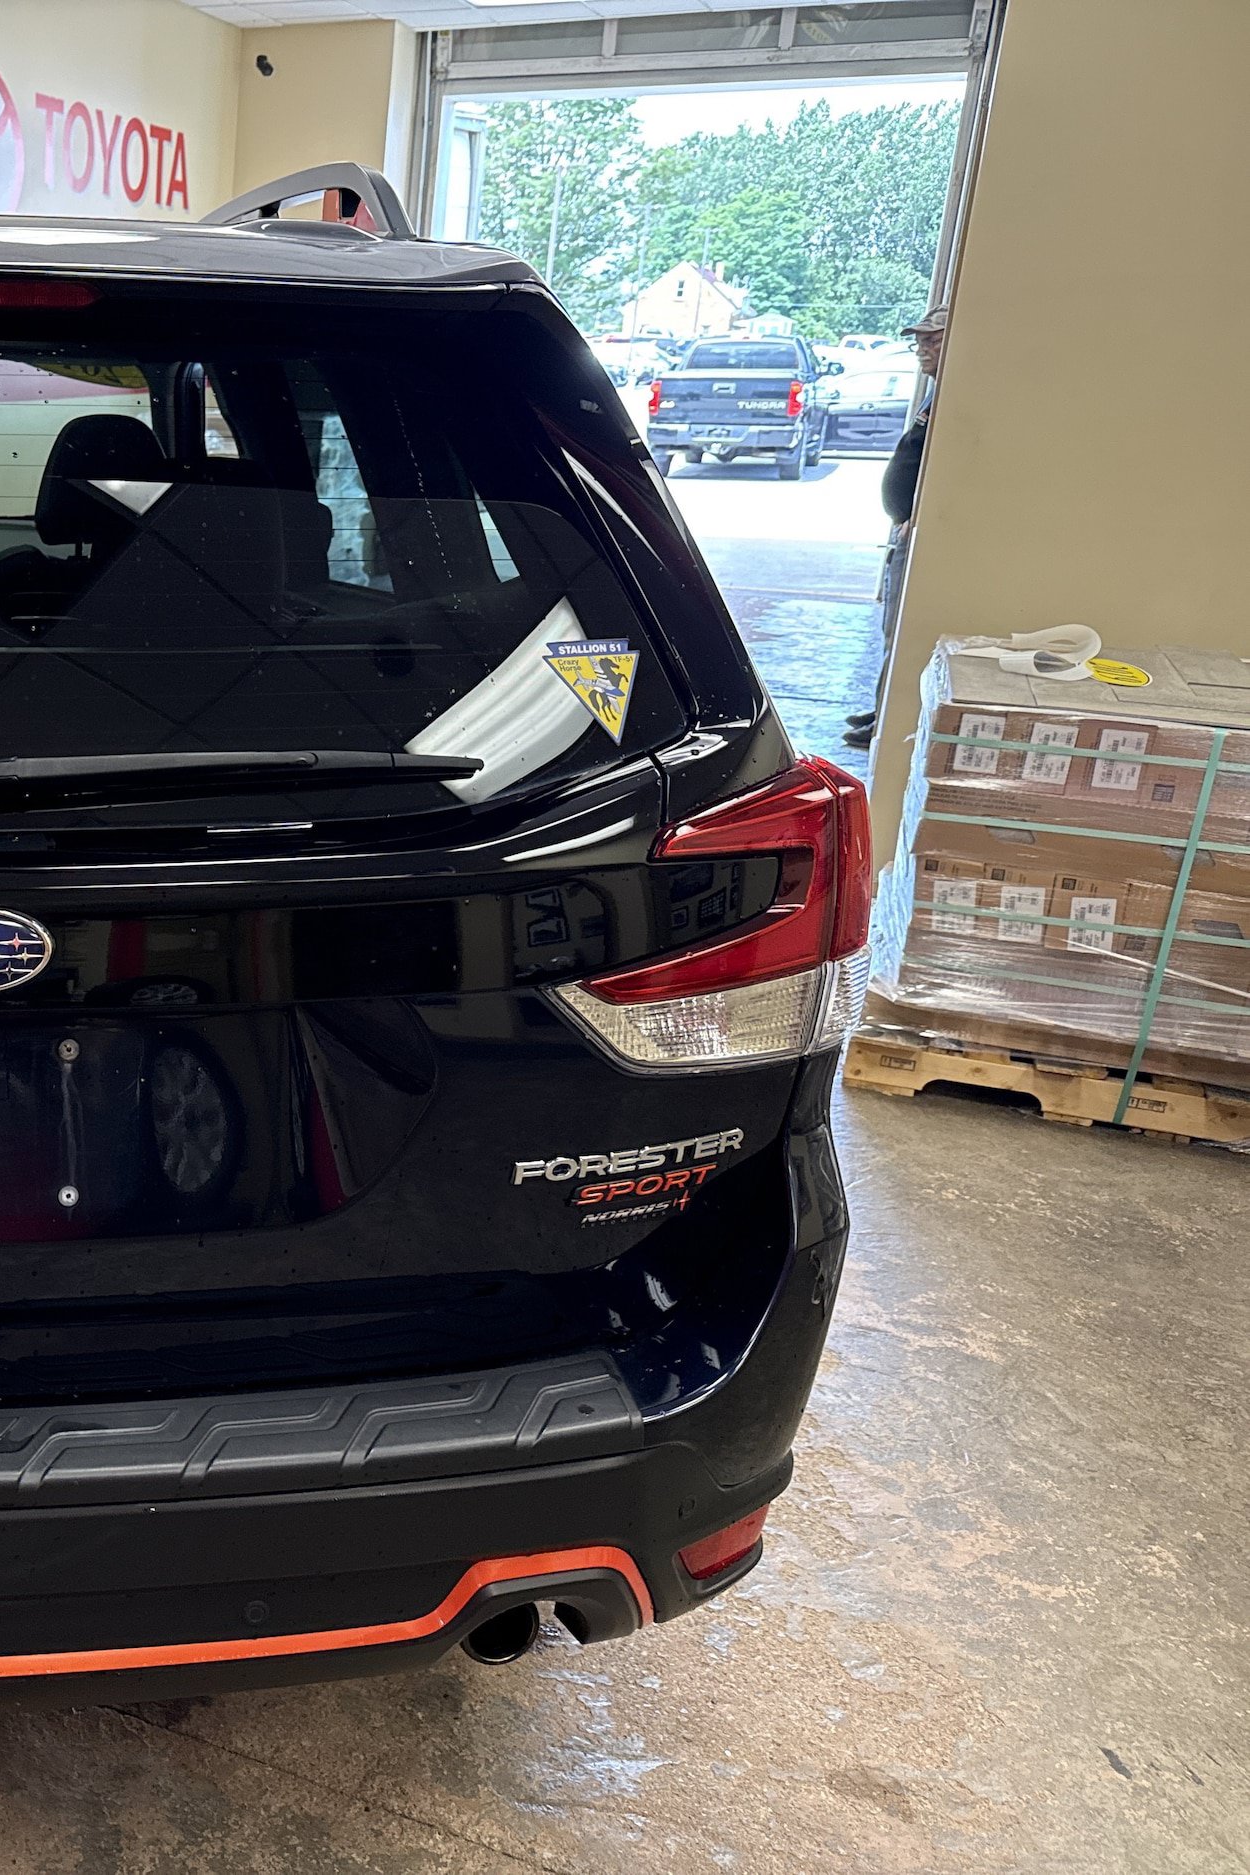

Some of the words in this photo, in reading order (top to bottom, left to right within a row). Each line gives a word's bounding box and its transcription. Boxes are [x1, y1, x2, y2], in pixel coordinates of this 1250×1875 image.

[35, 92, 189, 210] TOYOTA
[737, 400, 786, 410] TUNDRA
[558, 644, 607, 654] STALLION
[609, 643, 621, 652] 51
[557, 659, 579, 667] Crazy
[560, 664, 582, 672] Horse
[512, 1128, 745, 1185] FORESTER
[573, 1164, 717, 1206] SPORT
[581, 1200, 671, 1224] NORRIS
